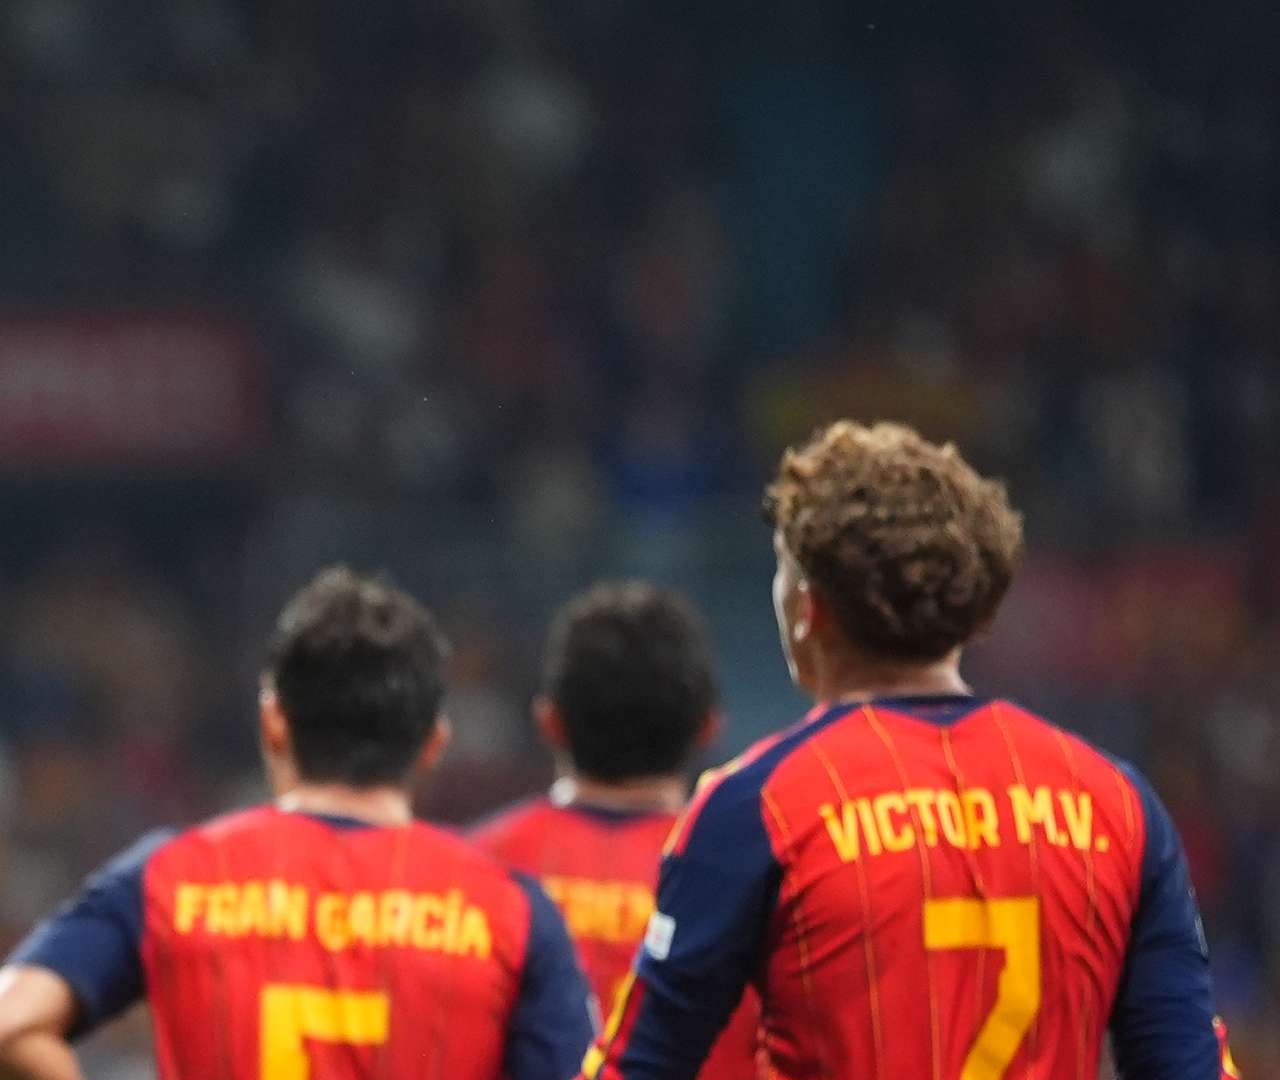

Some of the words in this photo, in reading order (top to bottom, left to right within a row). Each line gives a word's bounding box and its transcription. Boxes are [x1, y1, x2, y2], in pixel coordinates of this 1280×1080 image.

[819, 788, 1000, 862] VICTOR
[1008, 785, 1109, 851] M.V.
[174, 879, 310, 940] FRAN
[314, 888, 492, 960] GARCÍA
